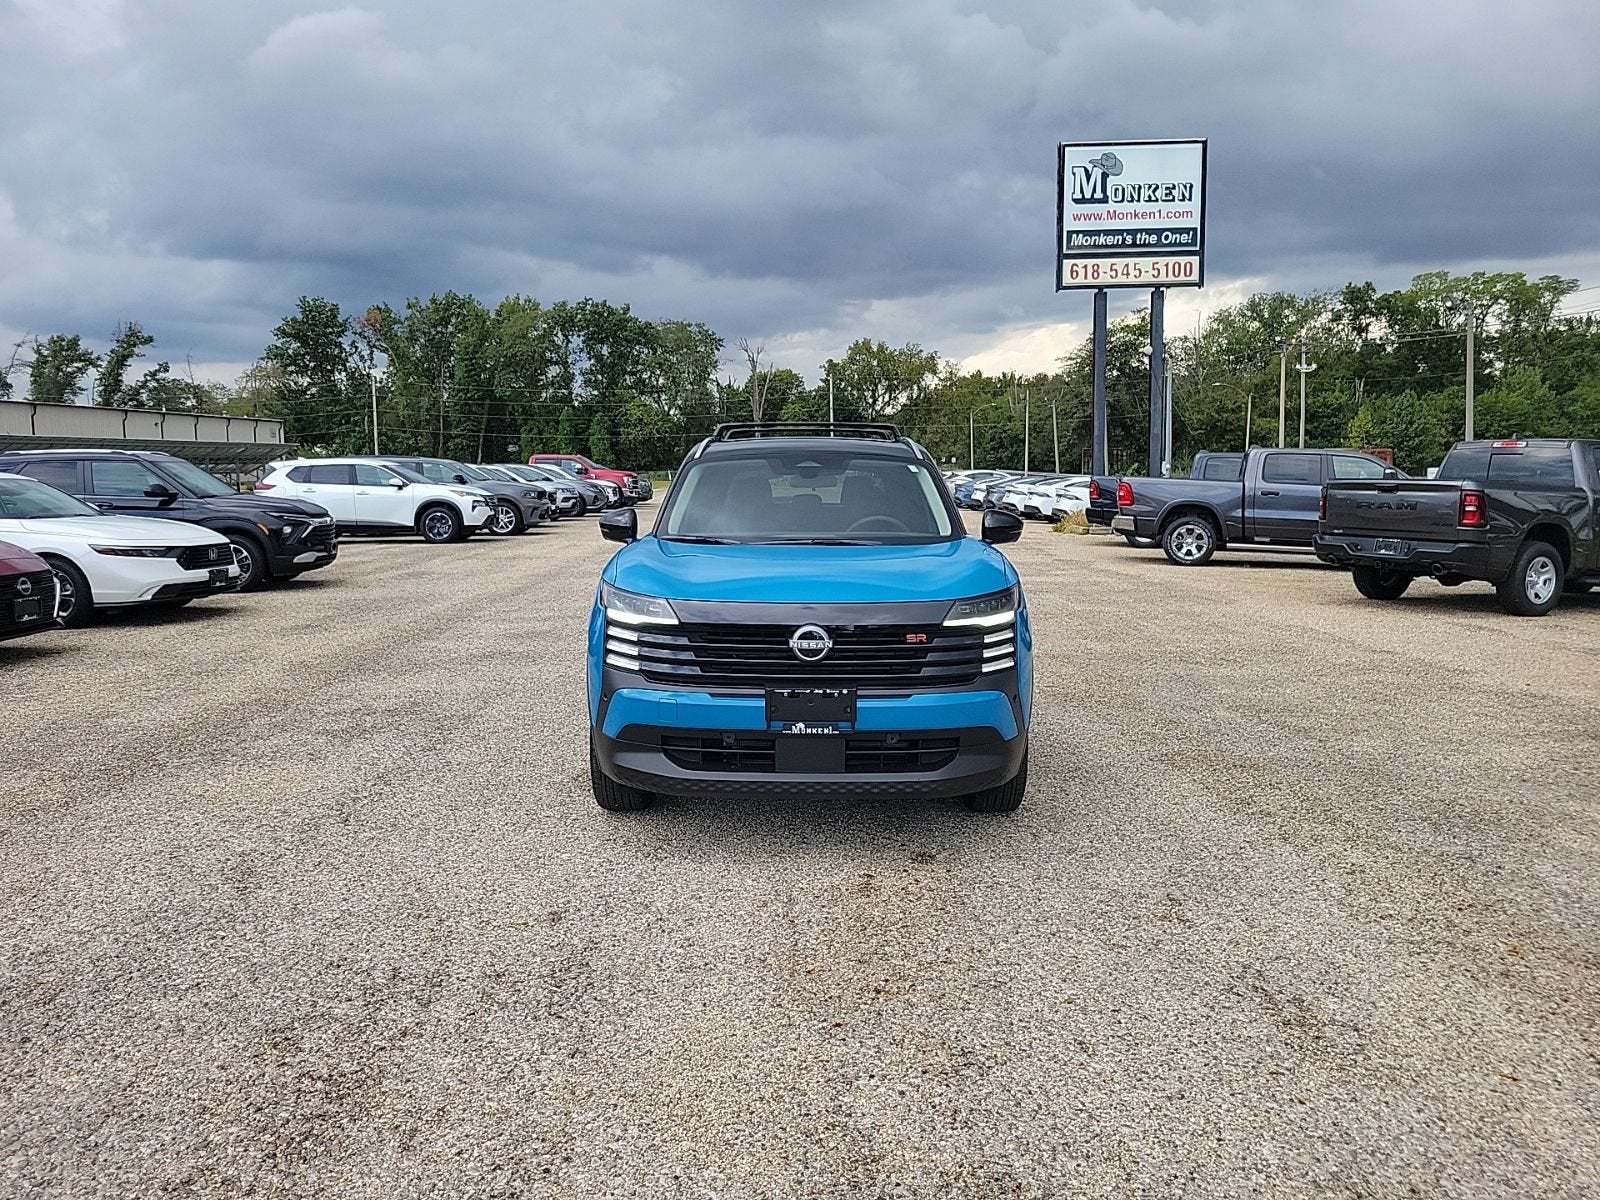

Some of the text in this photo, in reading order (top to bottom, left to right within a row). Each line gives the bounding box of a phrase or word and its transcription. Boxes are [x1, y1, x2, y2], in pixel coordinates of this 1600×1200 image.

[1072, 166, 1193, 204] MONKEN
[1072, 209, 1193, 222] www.Monken1.com
[1071, 231, 1193, 246] Monken's the One!
[1069, 261, 1194, 281] 618-545-5100
[1355, 501, 1418, 511] RAM
[789, 639, 833, 649] NISSAN
[906, 634, 927, 642] SR
